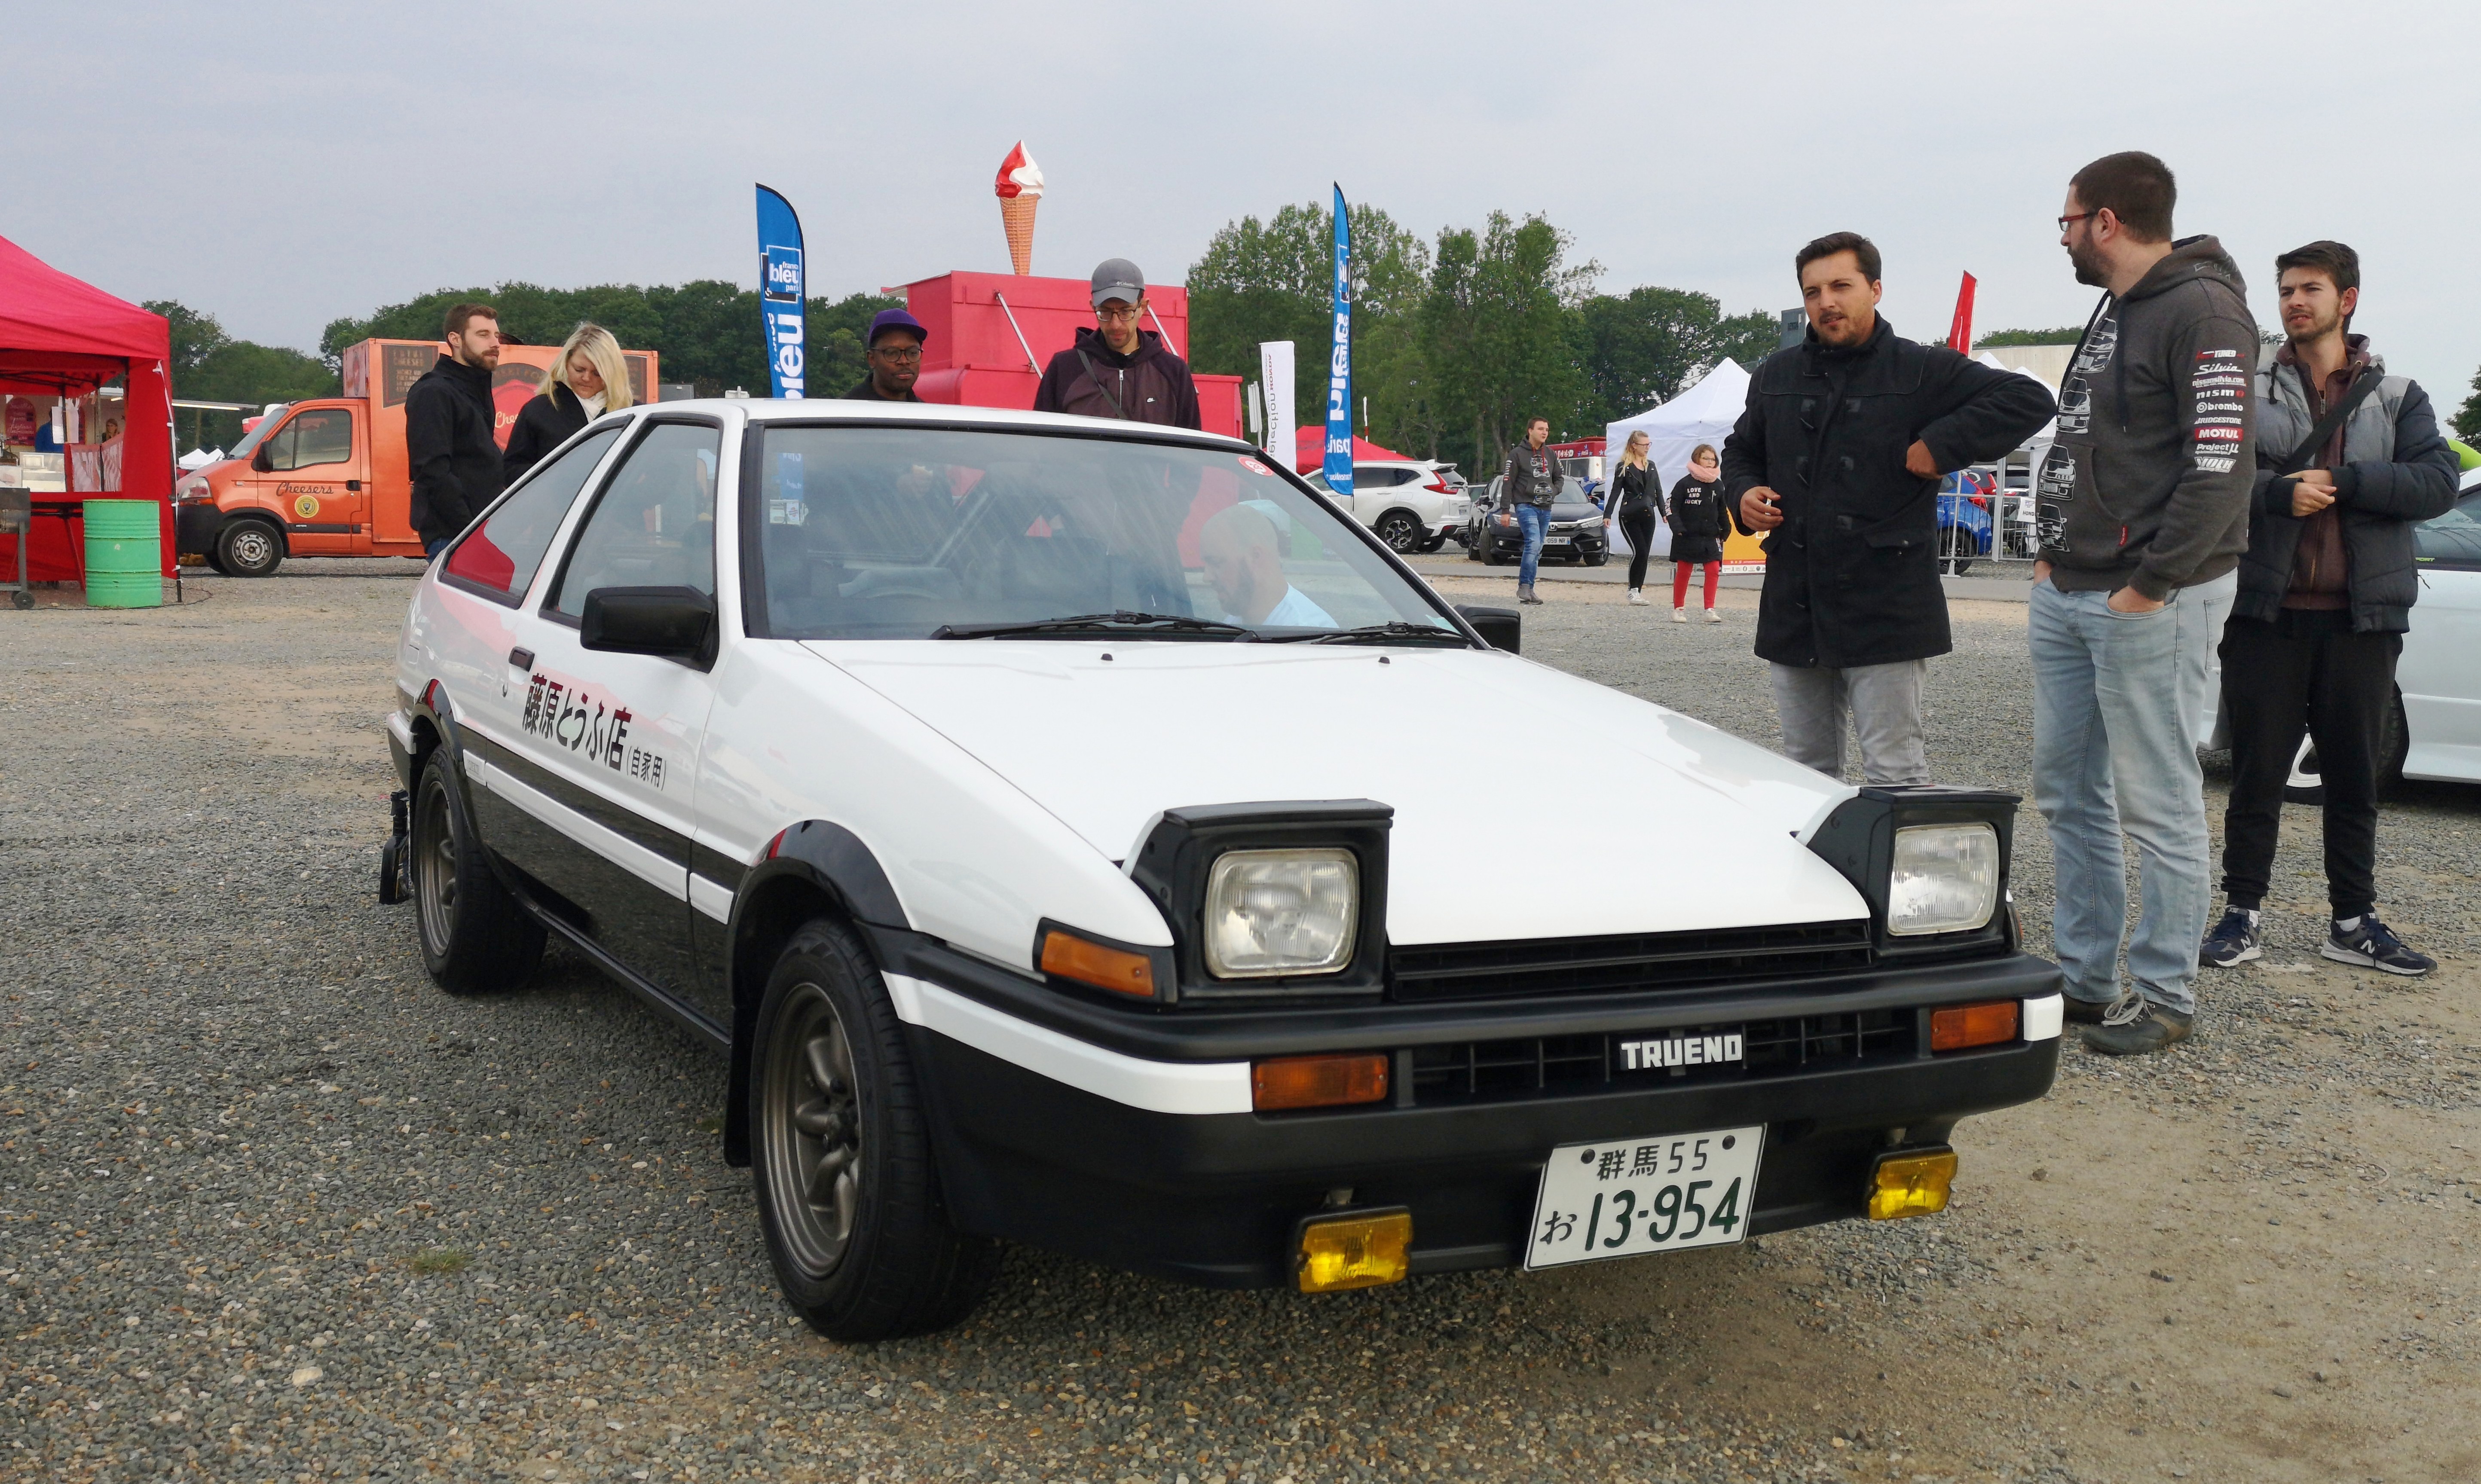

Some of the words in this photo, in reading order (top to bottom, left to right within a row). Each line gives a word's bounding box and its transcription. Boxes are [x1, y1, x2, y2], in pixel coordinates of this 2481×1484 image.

[769, 263, 799, 284] bleu
[786, 284, 799, 292] pari
[777, 314, 803, 399] leu
[2193, 363, 2243, 376] Silvia
[2207, 402, 2243, 411] brembo
[2198, 429, 2239, 438] MOTUL
[2196, 443, 2230, 451] Project
[276, 481, 334, 497] Cheesers
[522, 672, 632, 772] 藤原とうふ店
[1621, 1034, 1743, 1069] TRUENO
[1539, 1210, 1578, 1245] お
[1585, 1176, 1741, 1252] 13-954
